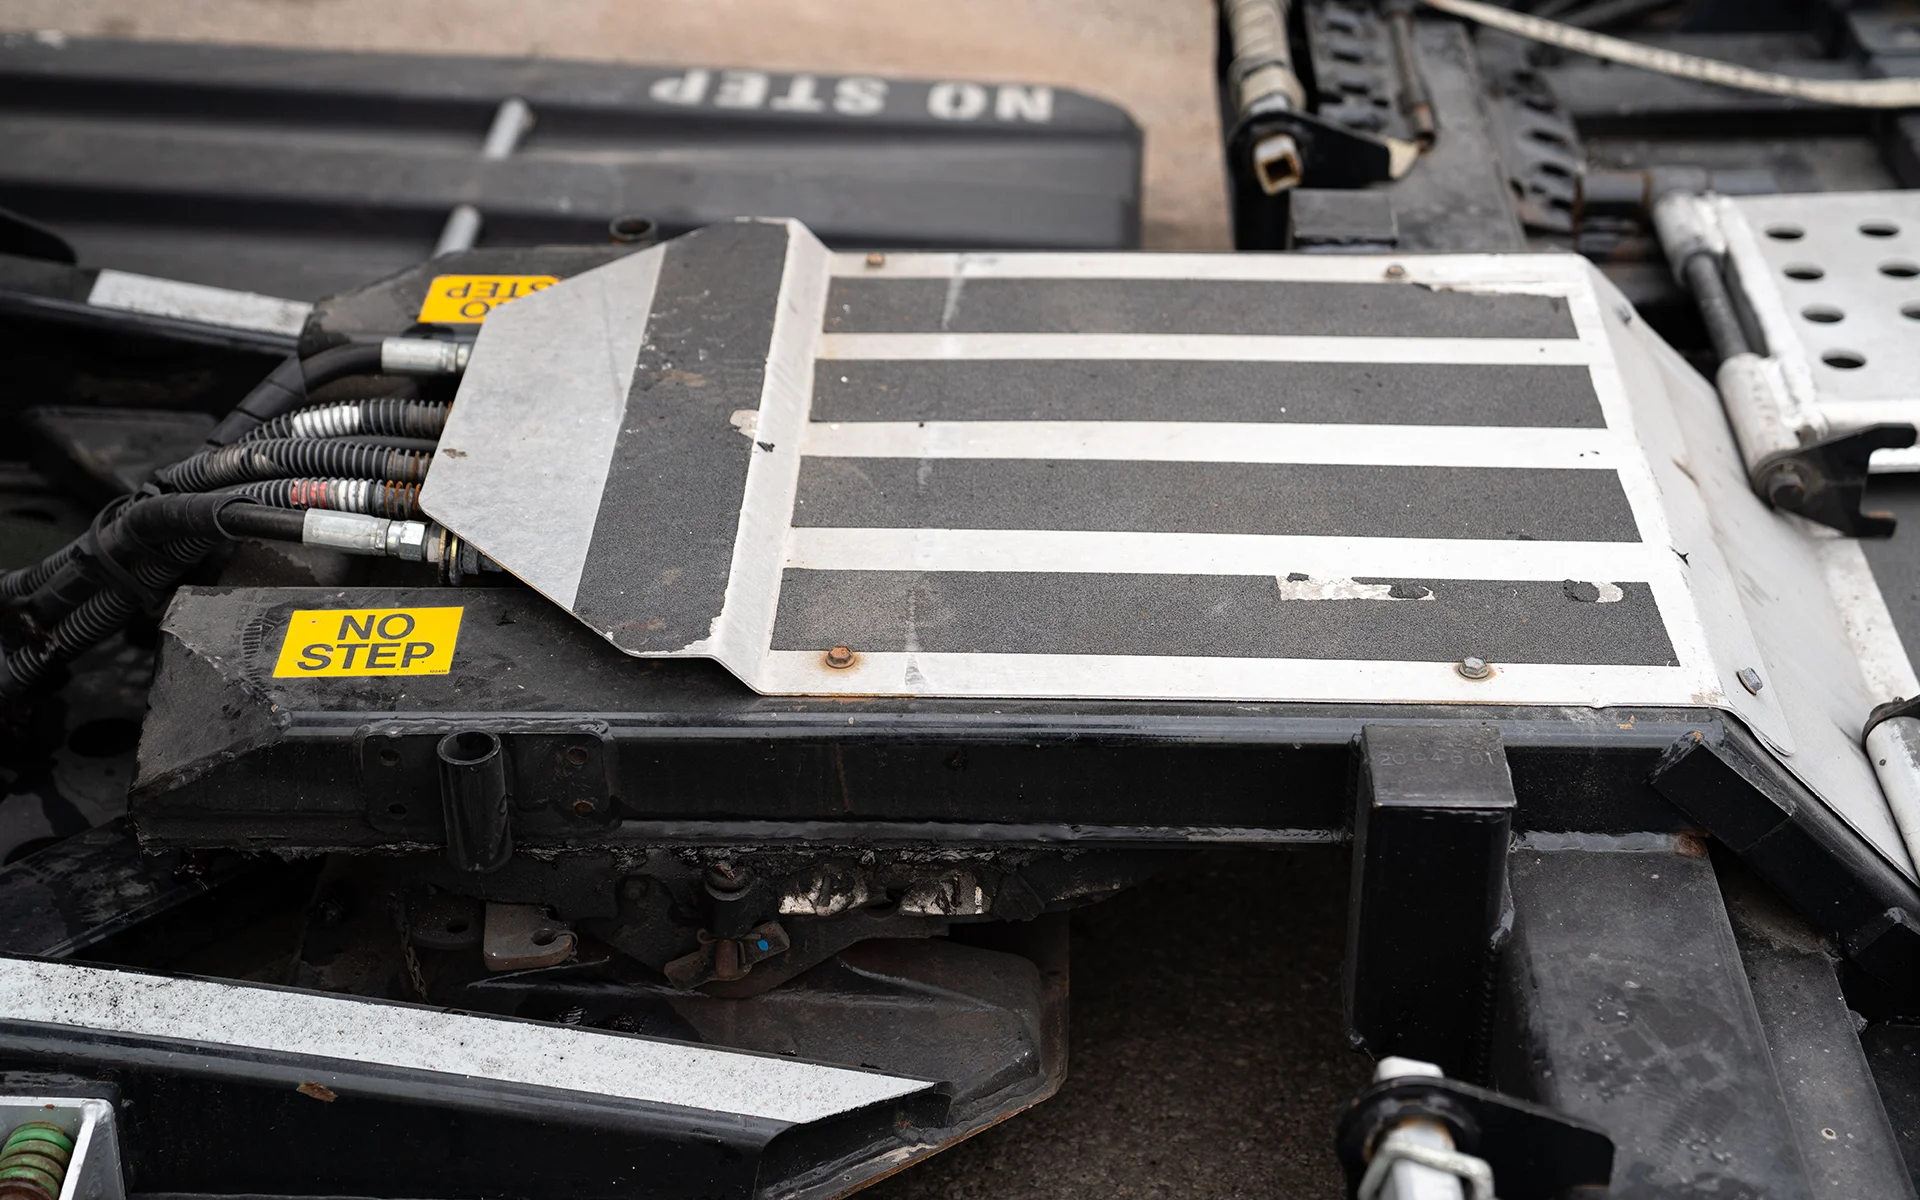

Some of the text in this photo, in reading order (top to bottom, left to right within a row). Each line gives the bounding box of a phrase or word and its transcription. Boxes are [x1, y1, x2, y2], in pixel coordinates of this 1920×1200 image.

[648, 67, 1054, 123] NO STEP
[459, 300, 505, 318] O
[336, 613, 416, 641] NO
[296, 642, 435, 671] STEP
